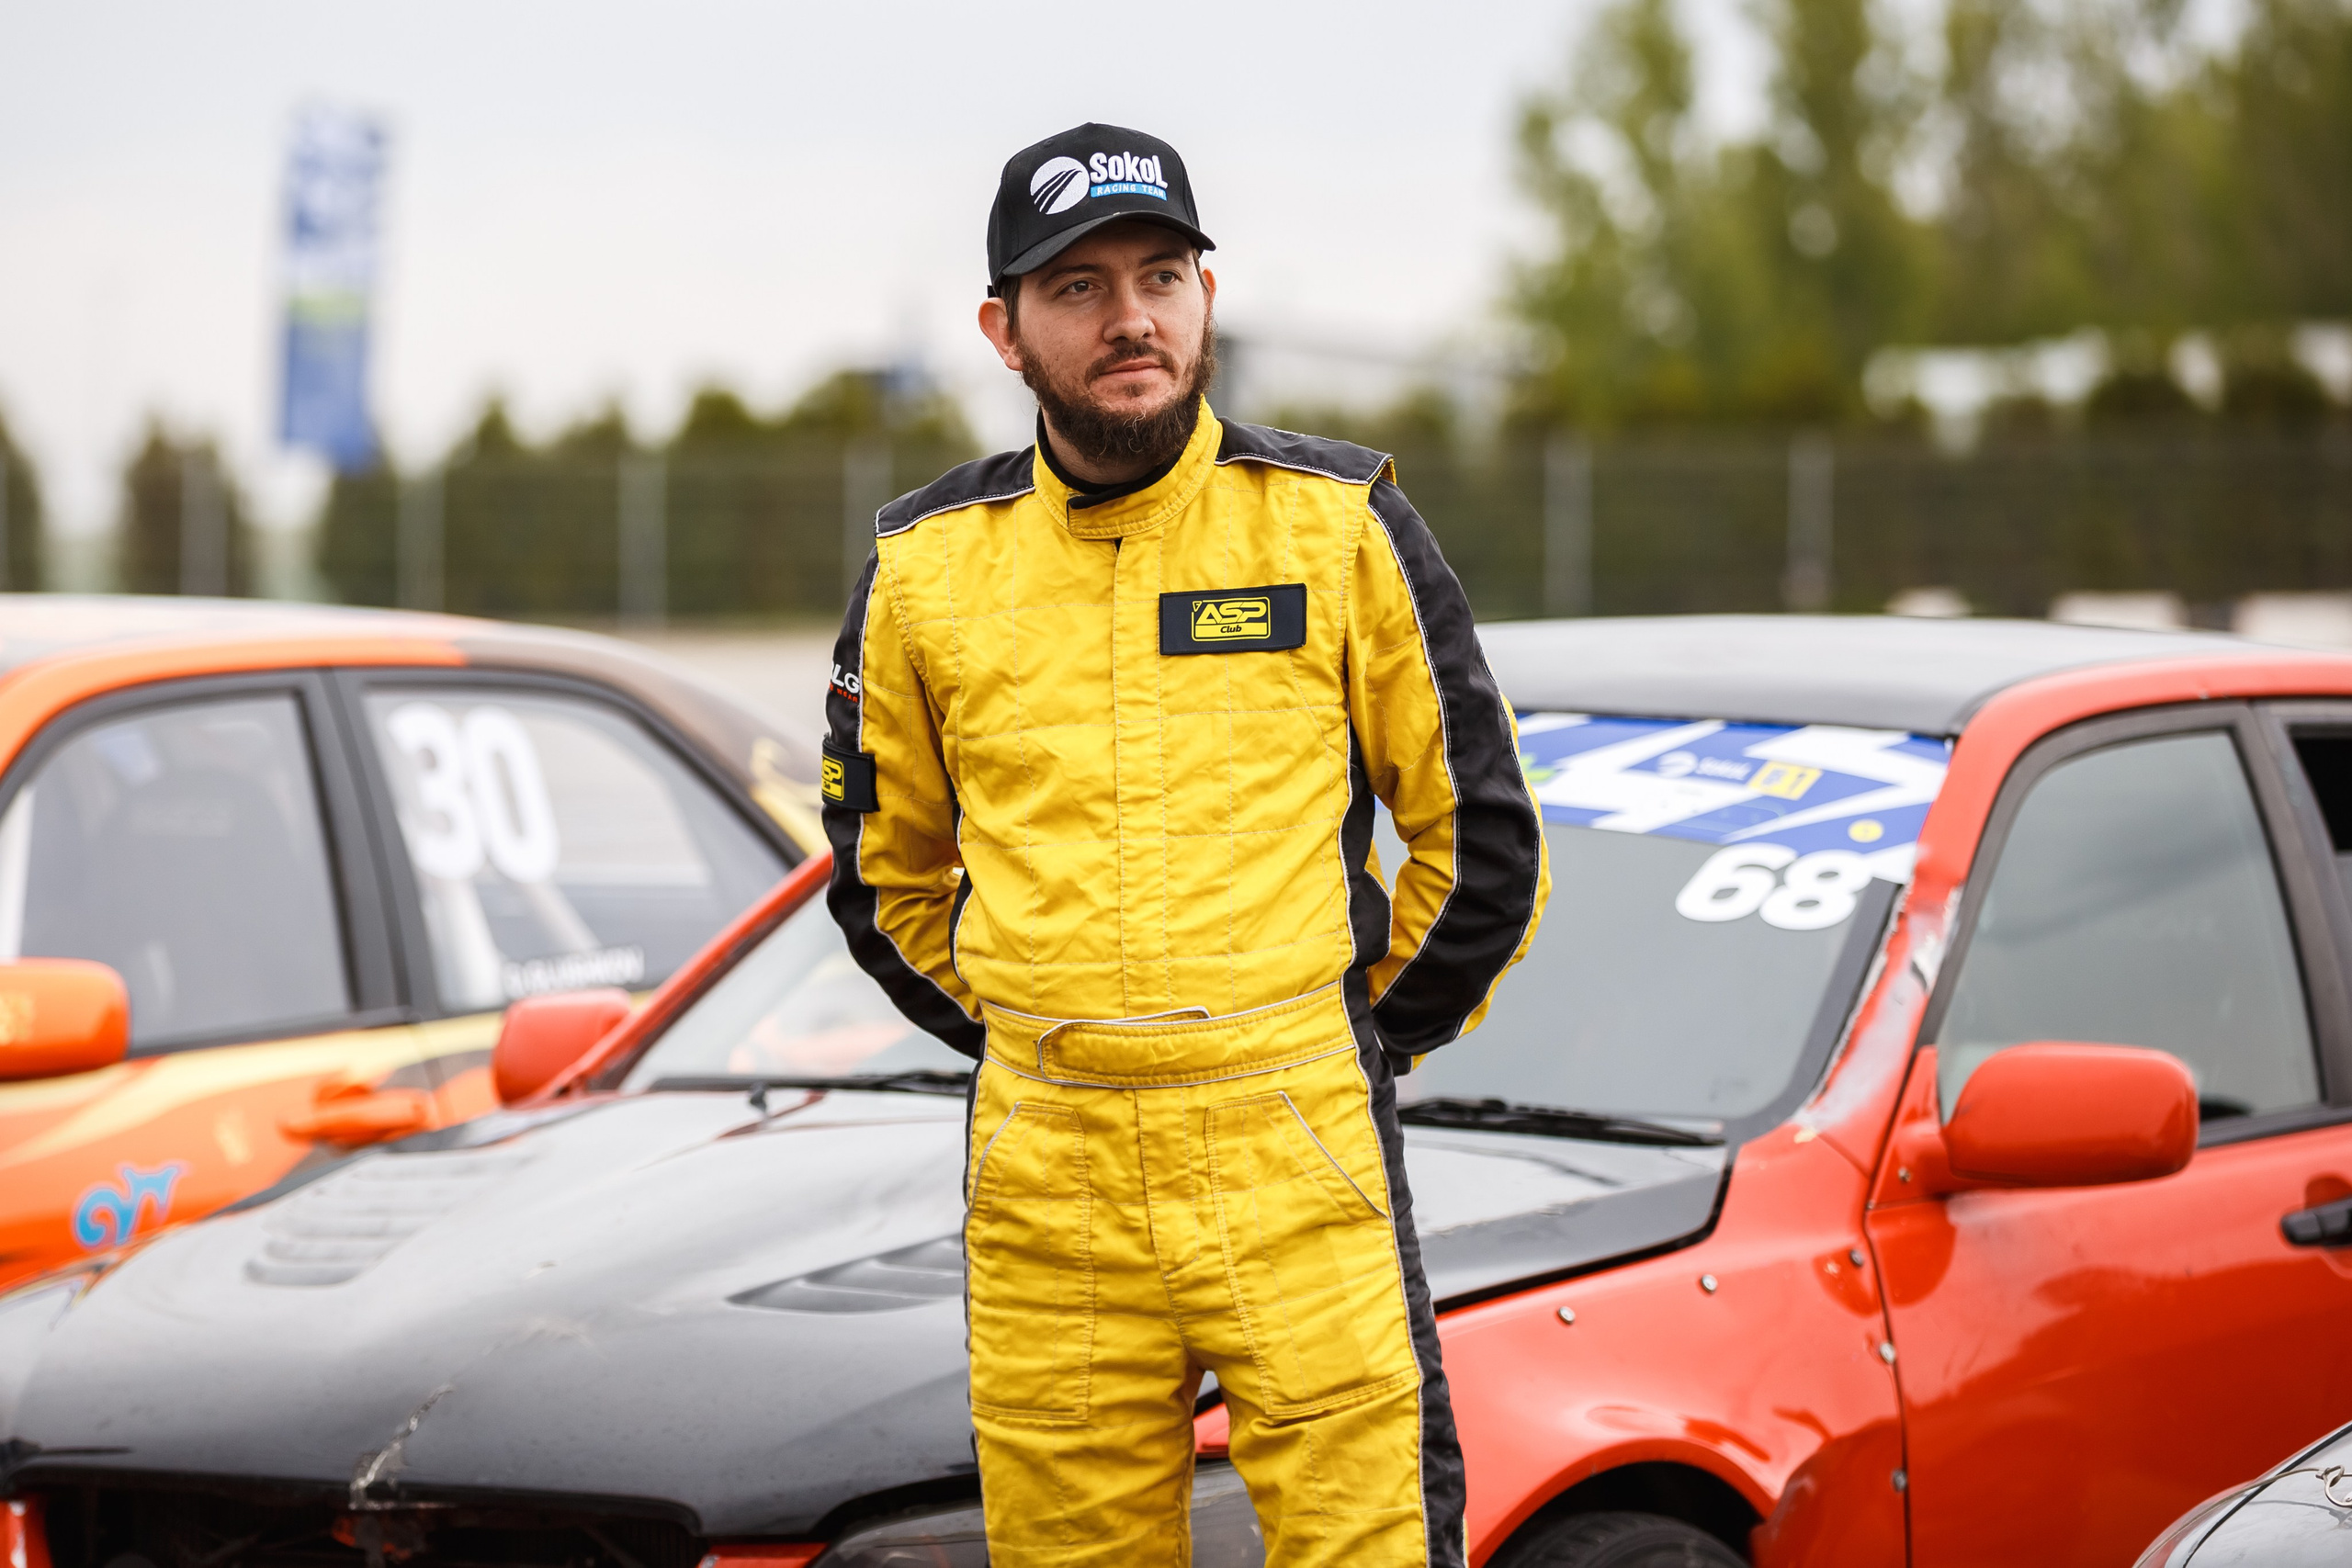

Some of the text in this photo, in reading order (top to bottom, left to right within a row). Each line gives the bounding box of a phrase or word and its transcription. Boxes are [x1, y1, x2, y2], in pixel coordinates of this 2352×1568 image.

[1096, 183, 1165, 197] RACING TEAM
[1195, 601, 1267, 625] ASP
[1220, 625, 1242, 634] Club
[821, 759, 842, 783] SP
[387, 701, 560, 883] 30
[1675, 842, 1872, 931] 68
